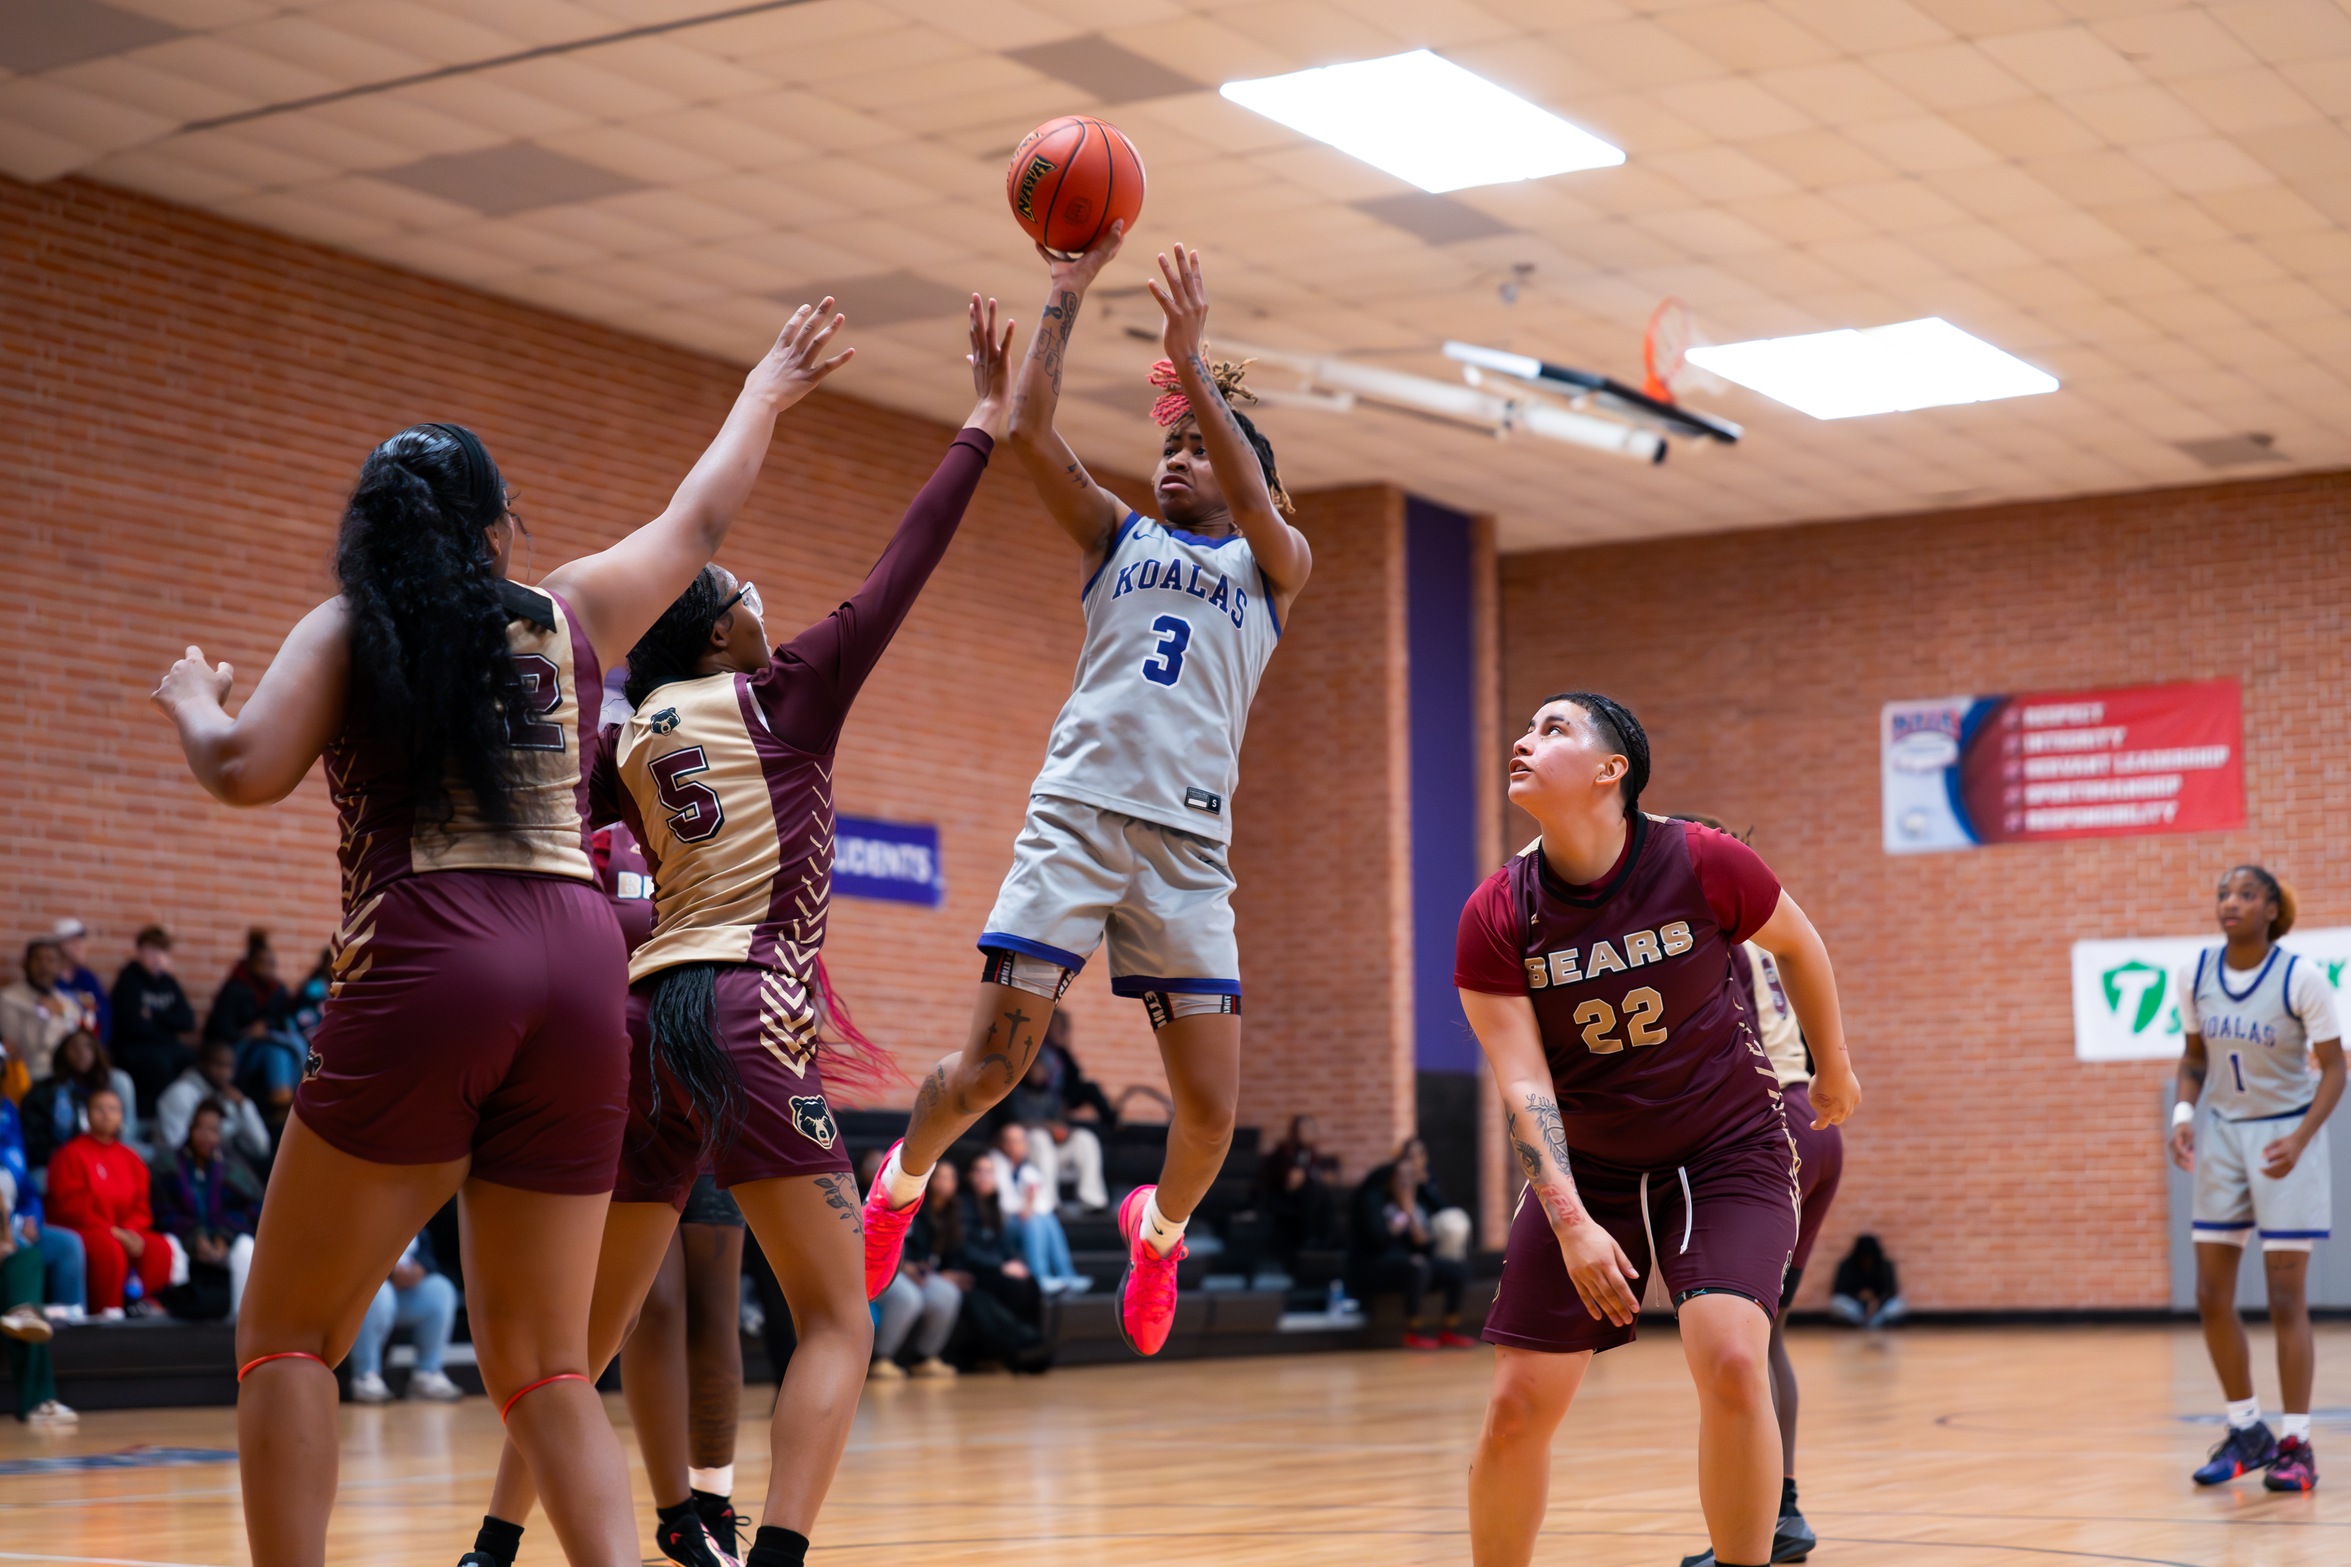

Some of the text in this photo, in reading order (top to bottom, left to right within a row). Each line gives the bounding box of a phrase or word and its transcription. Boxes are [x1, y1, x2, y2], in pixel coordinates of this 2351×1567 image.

[1018, 153, 1058, 224] NAIA
[1111, 558, 1249, 630] KOALAS
[1139, 612, 1194, 689] 3
[648, 745, 725, 844] 5
[1573, 986, 1668, 1054] 22
[2200, 1015, 2276, 1048] OALAS
[2229, 1053, 2245, 1092] 1
